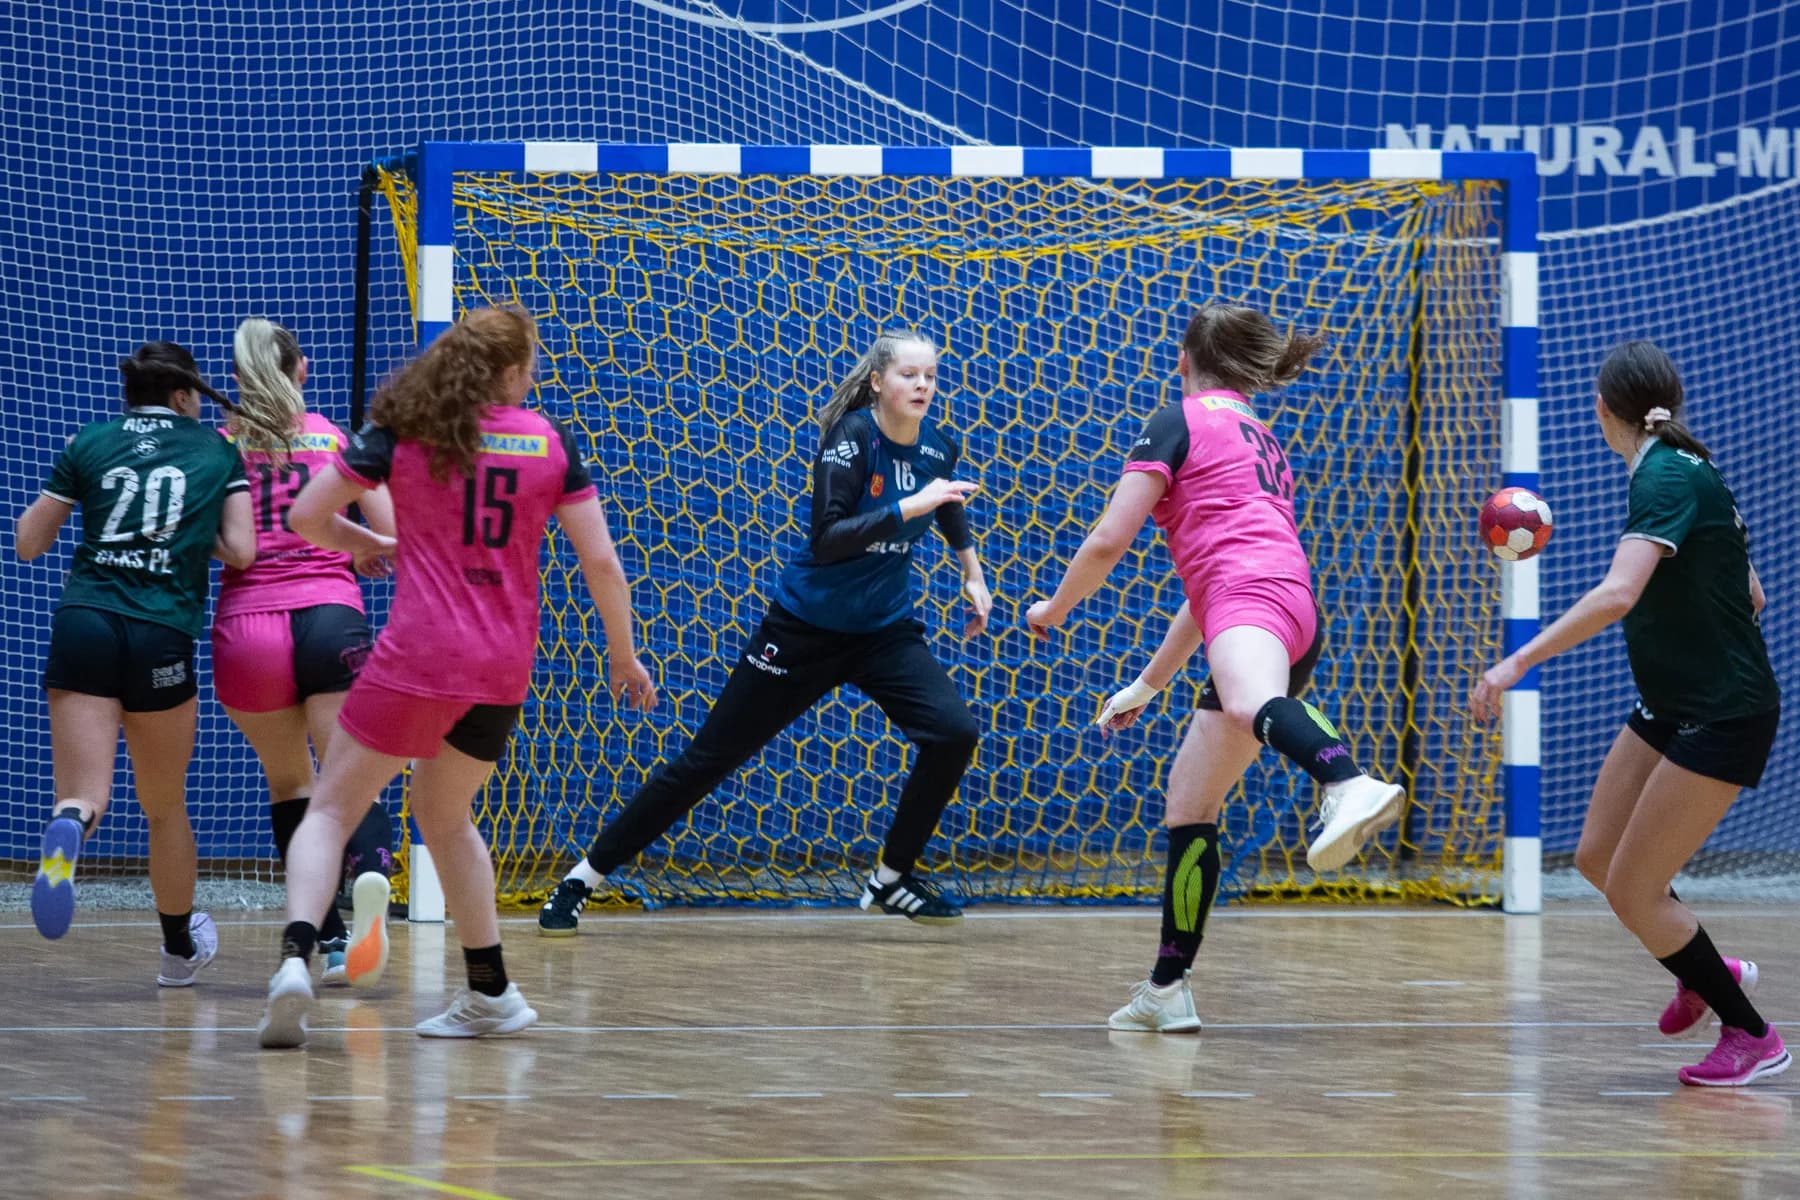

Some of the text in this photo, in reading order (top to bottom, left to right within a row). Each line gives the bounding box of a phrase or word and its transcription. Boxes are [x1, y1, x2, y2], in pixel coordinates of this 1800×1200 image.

[256, 463, 310, 533] 13
[892, 458, 916, 491] 16
[1239, 422, 1291, 501] 32
[99, 465, 186, 543] 20
[463, 466, 518, 549] 15
